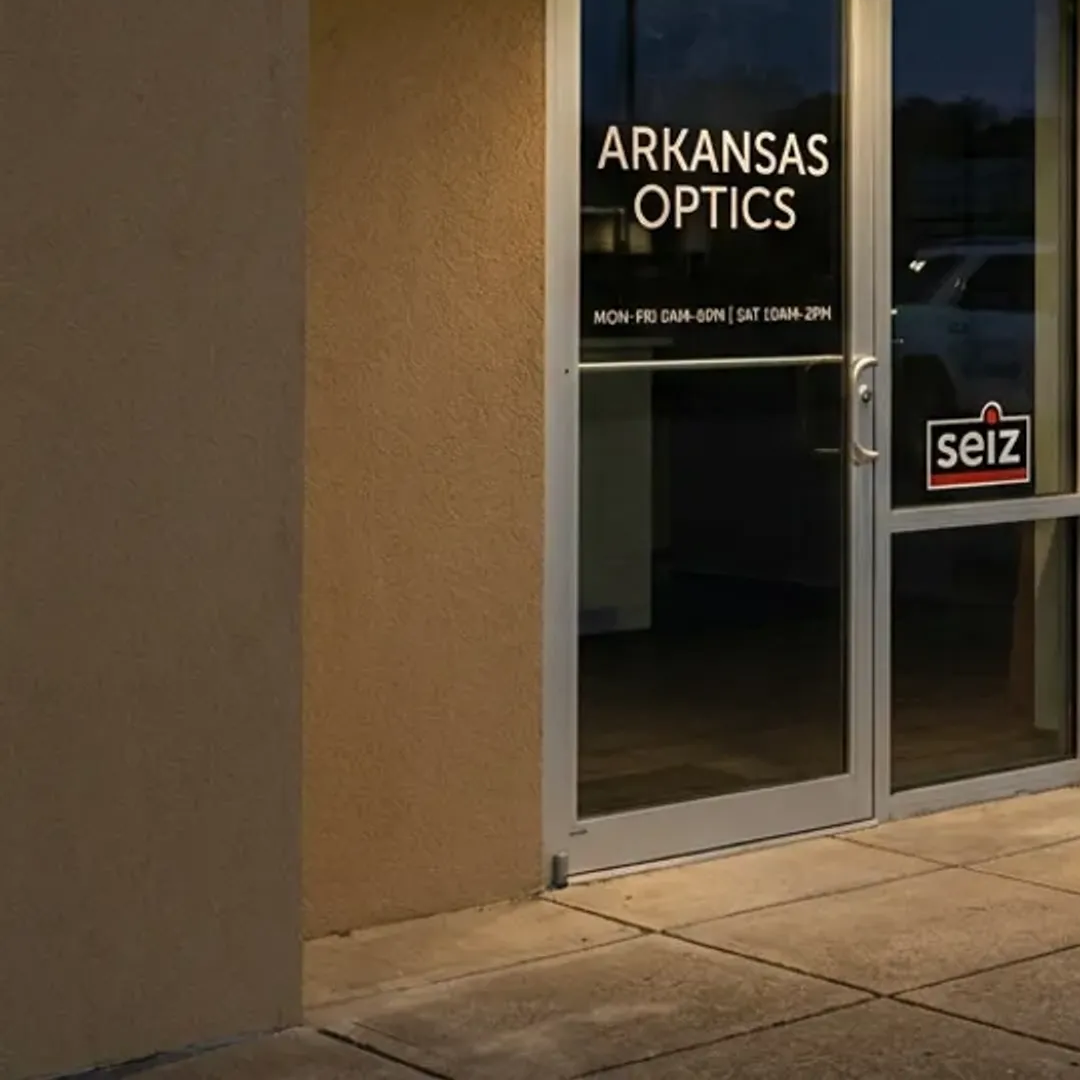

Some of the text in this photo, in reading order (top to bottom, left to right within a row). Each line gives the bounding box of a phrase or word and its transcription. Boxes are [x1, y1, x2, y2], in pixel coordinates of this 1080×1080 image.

[597, 125, 829, 177] ARKANSAS
[634, 184, 797, 231] OPTICS
[736, 307, 760, 324] SAT
